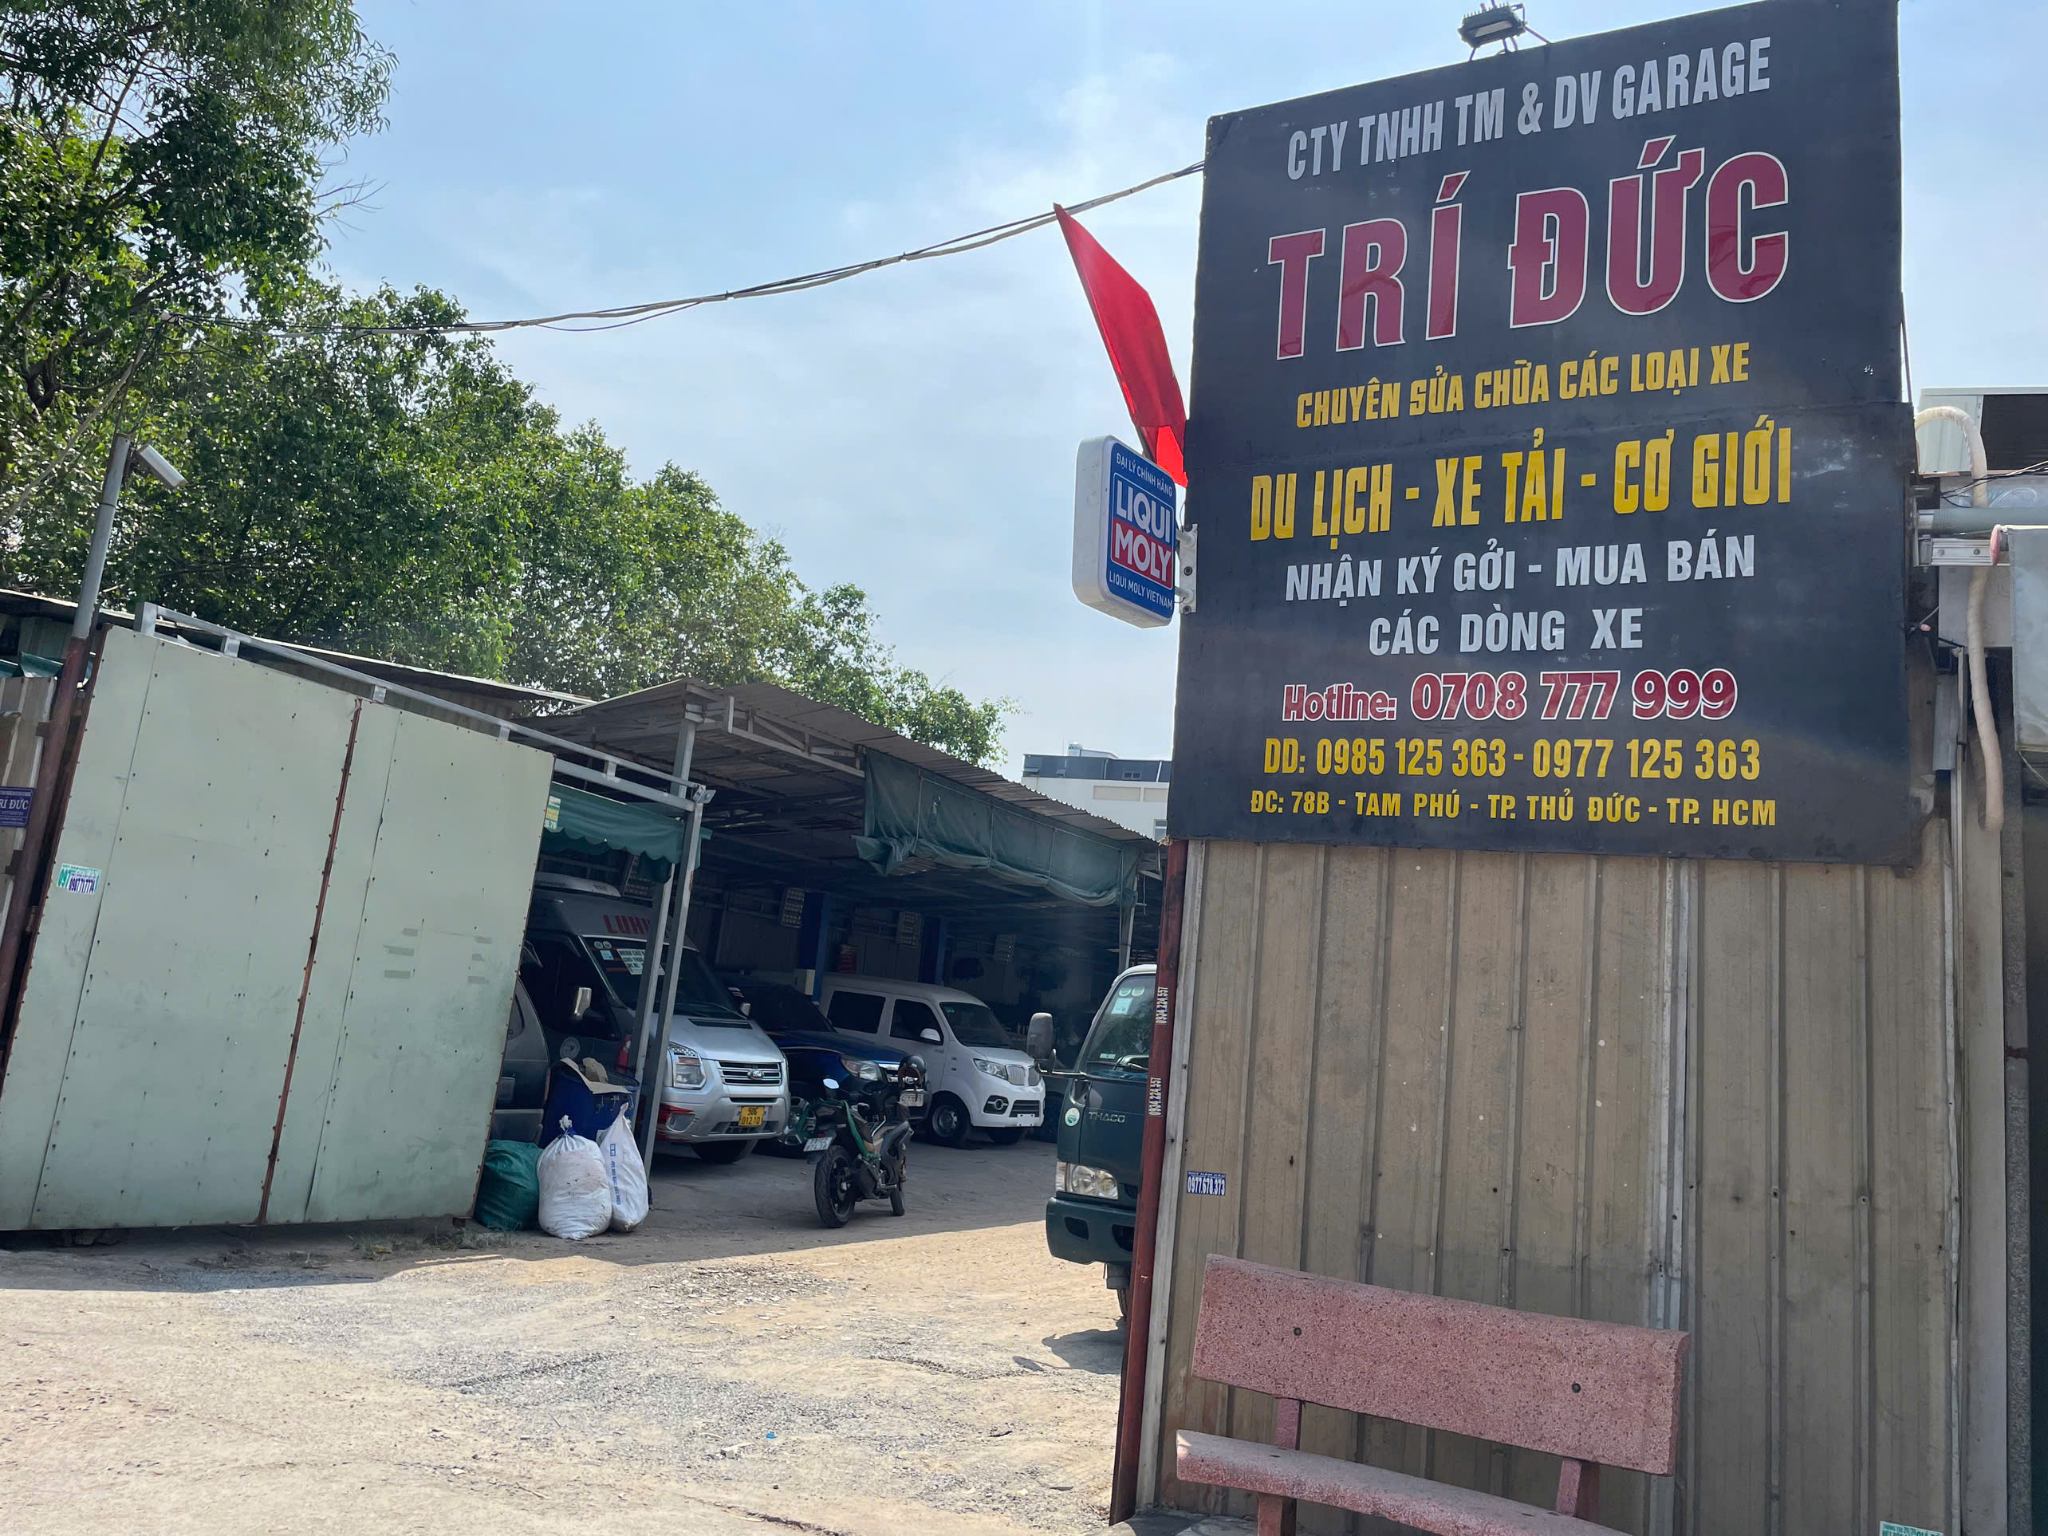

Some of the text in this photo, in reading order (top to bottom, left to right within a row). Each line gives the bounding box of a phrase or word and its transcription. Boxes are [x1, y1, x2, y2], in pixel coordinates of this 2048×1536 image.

[1287, 36, 1772, 181] CTY TNHH TM & DV GARAGE
[1267, 134, 1790, 361] TRÍ ĐỨC
[1296, 341, 1751, 429] CHUYÊN SỬA CHỮA CÁC LOẠI XE
[1116, 452, 1173, 498] ĐẠI LÝ CHÍNH HÀNG
[1250, 414, 1793, 550] DU LỊCH - XE TẢI - CƠ GIỚI
[1116, 480, 1171, 543] LIQUI
[1114, 522, 1172, 583] MOLY
[1285, 553, 1382, 608] NHẬN
[1397, 545, 1440, 597] KÝ
[1453, 537, 1516, 593] GỞI
[1555, 542, 1648, 587] MUA
[1667, 528, 1756, 582] BÁN
[1108, 570, 1174, 610] LIQUI MOLY VIETNAM
[1369, 602, 1644, 656] CÁC DÒNG XE
[1281, 667, 1739, 723] Hotline: 0708 777 999
[1263, 737, 1306, 775] DD:
[1315, 738, 1387, 776] 0985
[1396, 738, 1443, 777] 125
[1626, 738, 1684, 779] 125
[1694, 738, 1761, 781] 363
[1250, 789, 1284, 814] ĐC:
[1290, 790, 1331, 815] 78B
[1354, 792, 1401, 817] TAM
[1413, 789, 1461, 819] PHÚ
[1488, 795, 1516, 821] TP.
[1526, 787, 1575, 822] THỦ
[1587, 792, 1641, 824] ĐỨC
[1666, 797, 1701, 825] TP.
[1712, 799, 1778, 828] HCM
[1088, 1112, 1126, 1123] THACO
